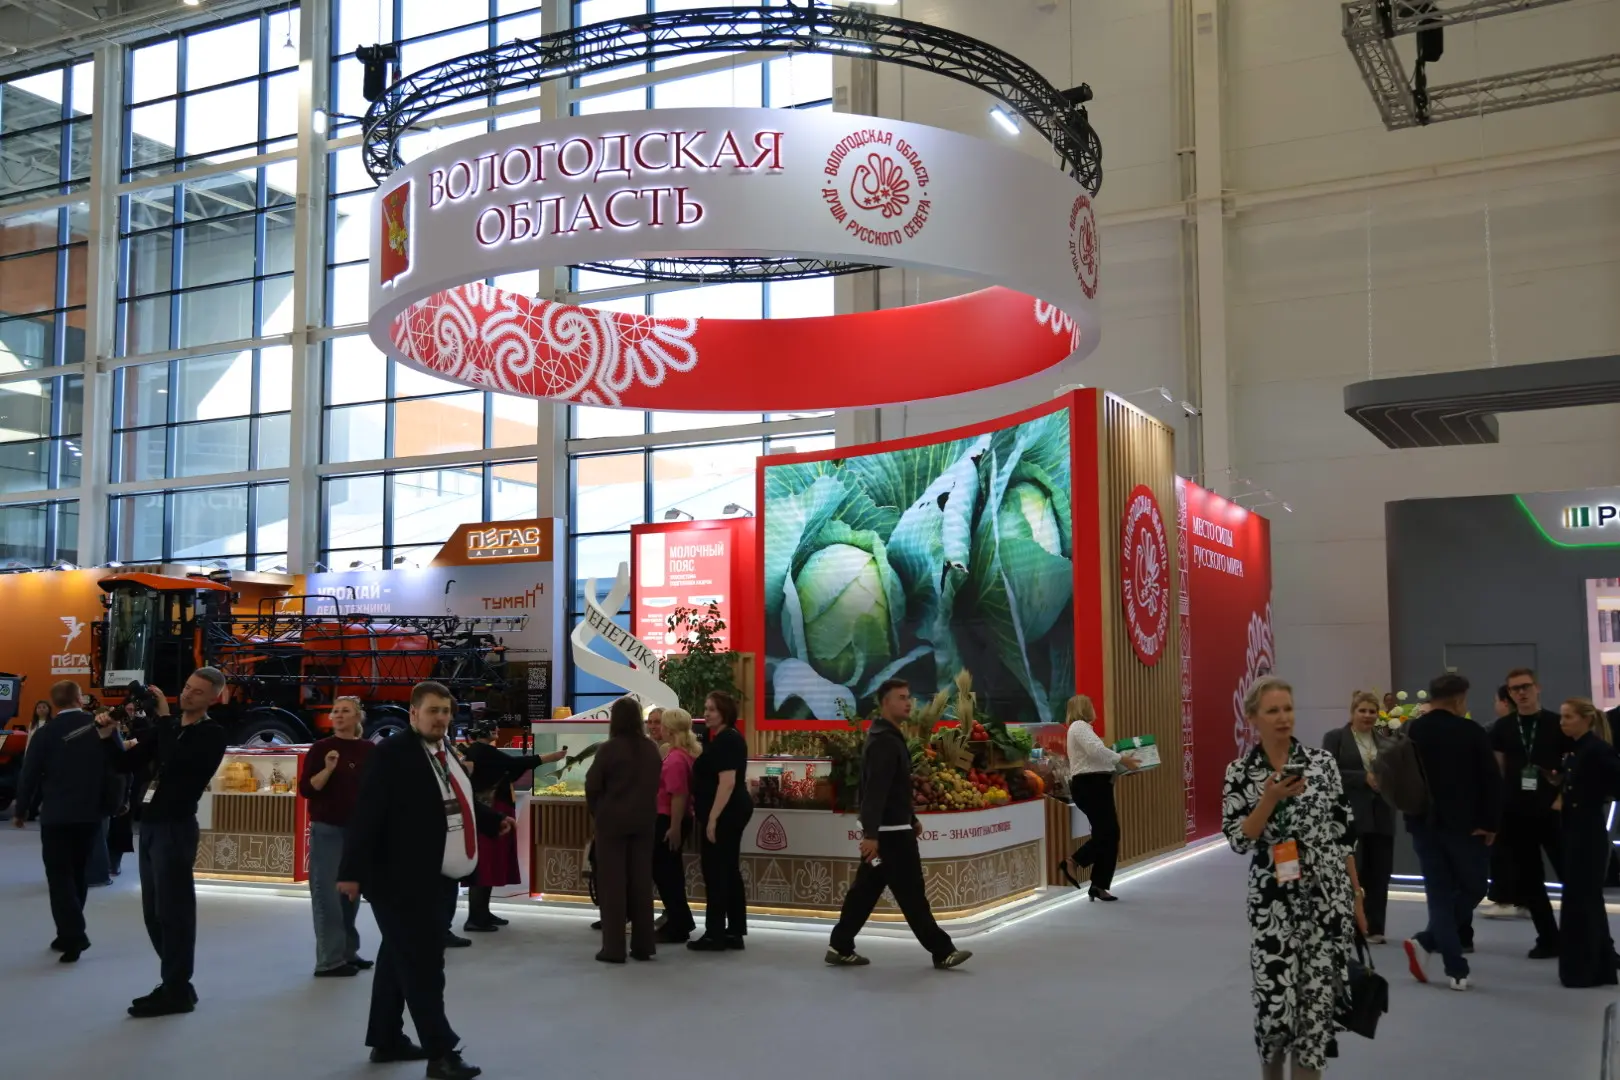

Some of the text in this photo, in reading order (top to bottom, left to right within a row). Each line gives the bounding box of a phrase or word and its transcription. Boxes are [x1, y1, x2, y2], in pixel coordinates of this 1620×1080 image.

[428, 130, 785, 209] ВОЛОГОДСКАЯ
[824, 129, 930, 188] ВОЛОГОДСКАЯ ОБЛАСТЬ
[475, 187, 704, 246] ОБЛАСТЬ
[821, 188, 931, 246] ДУША РУССКОГО СЕВЕРА
[467, 528, 540, 549] ПЕГАС
[1192, 515, 1215, 541] МЕСТО
[475, 547, 530, 557] АГРО
[669, 542, 725, 558] МОЛОЧНЫЙ
[1193, 544, 1244, 578] РУССКОГО МИРА
[669, 559, 695, 573] ПОЯС
[586, 604, 657, 676] ГЕНЕТИКА
[51, 653, 92, 667] ПЕГА
